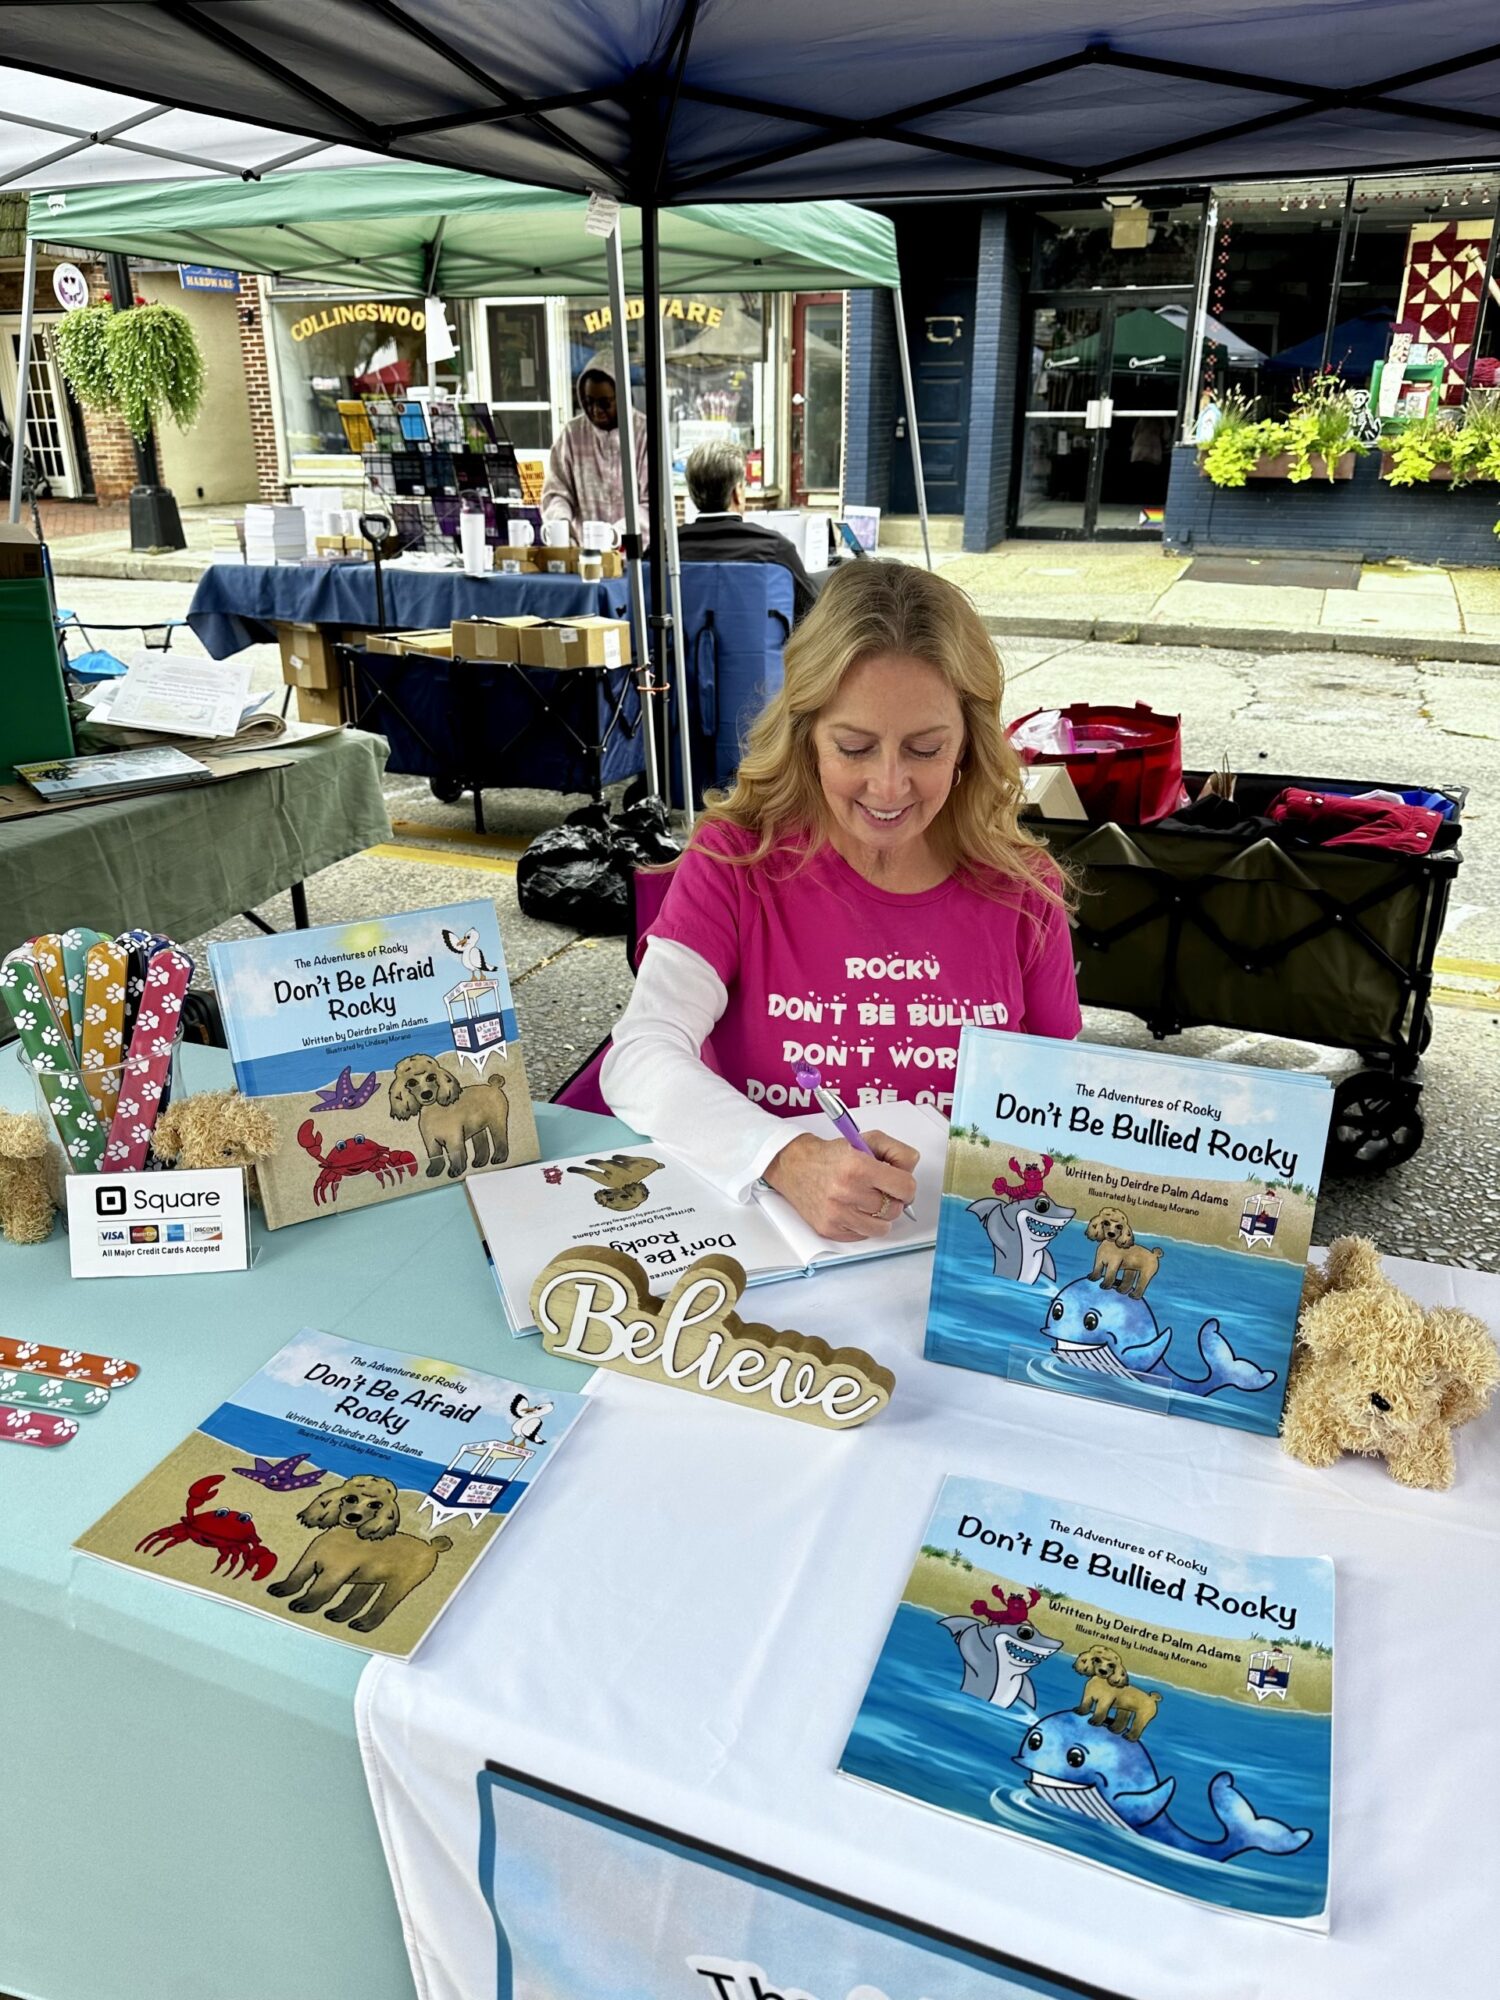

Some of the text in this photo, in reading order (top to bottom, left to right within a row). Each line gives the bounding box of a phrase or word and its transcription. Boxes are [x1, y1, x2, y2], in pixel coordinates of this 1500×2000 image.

[186, 276, 234, 289] HARDWARE
[294, 943, 408, 969] The Adventures of Rocky
[845, 957, 940, 981] ROCKY
[274, 956, 435, 1004] Don't Be Afraid
[328, 992, 396, 1021] Rocky
[768, 993, 1009, 1027] DON'T BE BULLIED
[302, 1017, 429, 1047] Written by Deirdre Palm Adams
[782, 1040, 960, 1070] DON'T WOR
[857, 1087, 898, 1108] BE
[1075, 1083, 1222, 1122] The Adventures of Rocky
[996, 1093, 1298, 1178] Don't Be Bullied Rocky
[134, 1190, 220, 1214] Square
[1065, 1166, 1229, 1207] Written by Deirdre Palm Adams
[1088, 1187, 1200, 1217] Illustrated by Lindsay Morano
[102, 1232, 124, 1240] VISA
[572, 1207, 696, 1240] Written by Deirdre Palm Adams
[114, 1249, 135, 1258] Major
[136, 1246, 160, 1256] Credit
[162, 1246, 184, 1254] Cards
[186, 1244, 220, 1254] Accepted
[609, 1230, 681, 1254] Rocky
[644, 1233, 737, 1265] Don't Be
[649, 1263, 692, 1281] ventures
[538, 1271, 879, 1421] Believe
[350, 1356, 468, 1394] The Adventures of Rocky
[304, 1363, 482, 1423] Don't Be Afraid
[334, 1396, 410, 1435] Rocky
[286, 1410, 424, 1457] Written by Deirdre Palm Adams
[1050, 1520, 1209, 1576] The Adventures of Rocky
[957, 1515, 1298, 1630] Don't Be Bullied Rocky
[1048, 1600, 1242, 1664] Written by Deirdre Palm Adams
[1075, 1624, 1208, 1670] Illustrated by Lindsay Morano
